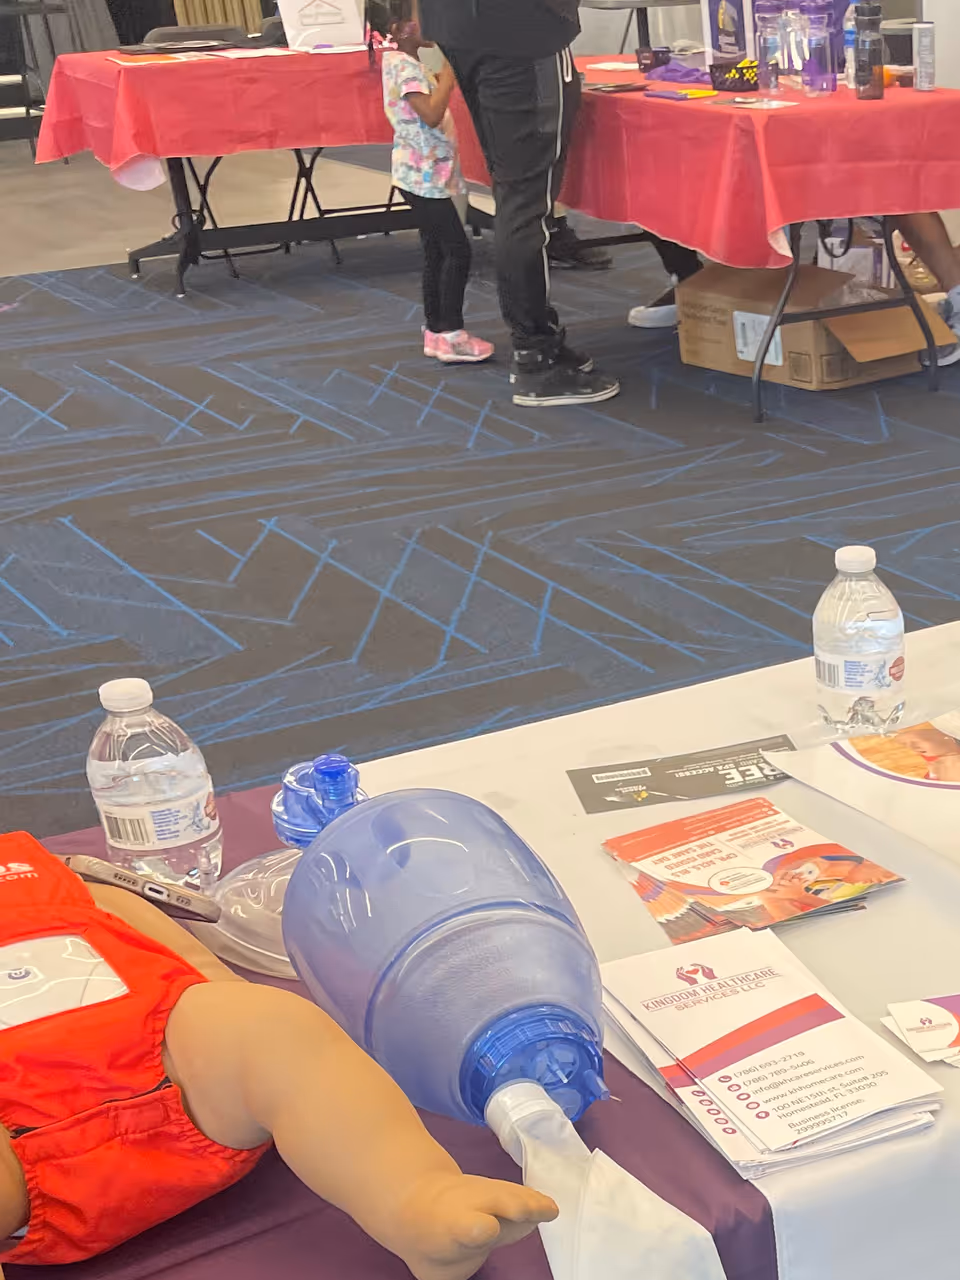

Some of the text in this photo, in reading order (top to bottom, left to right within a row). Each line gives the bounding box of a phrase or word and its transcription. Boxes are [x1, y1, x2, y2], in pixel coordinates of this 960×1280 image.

[642, 968, 778, 1011] KINGDOM HEALTHCARE
[674, 981, 766, 1012] SERVICES LLC
[733, 1051, 805, 1079] (786) 693-2719
[742, 1059, 816, 1088] (786) 789-5406
[752, 1054, 865, 1096] info@khcareservices.com
[762, 1066, 865, 1104] www.khhomecare.com
[771, 1101, 791, 1113] 100
[870, 1069, 890, 1080] 205
[777, 1081, 879, 1120] Homestead, FL 33030
[788, 1110, 830, 1130] Business
